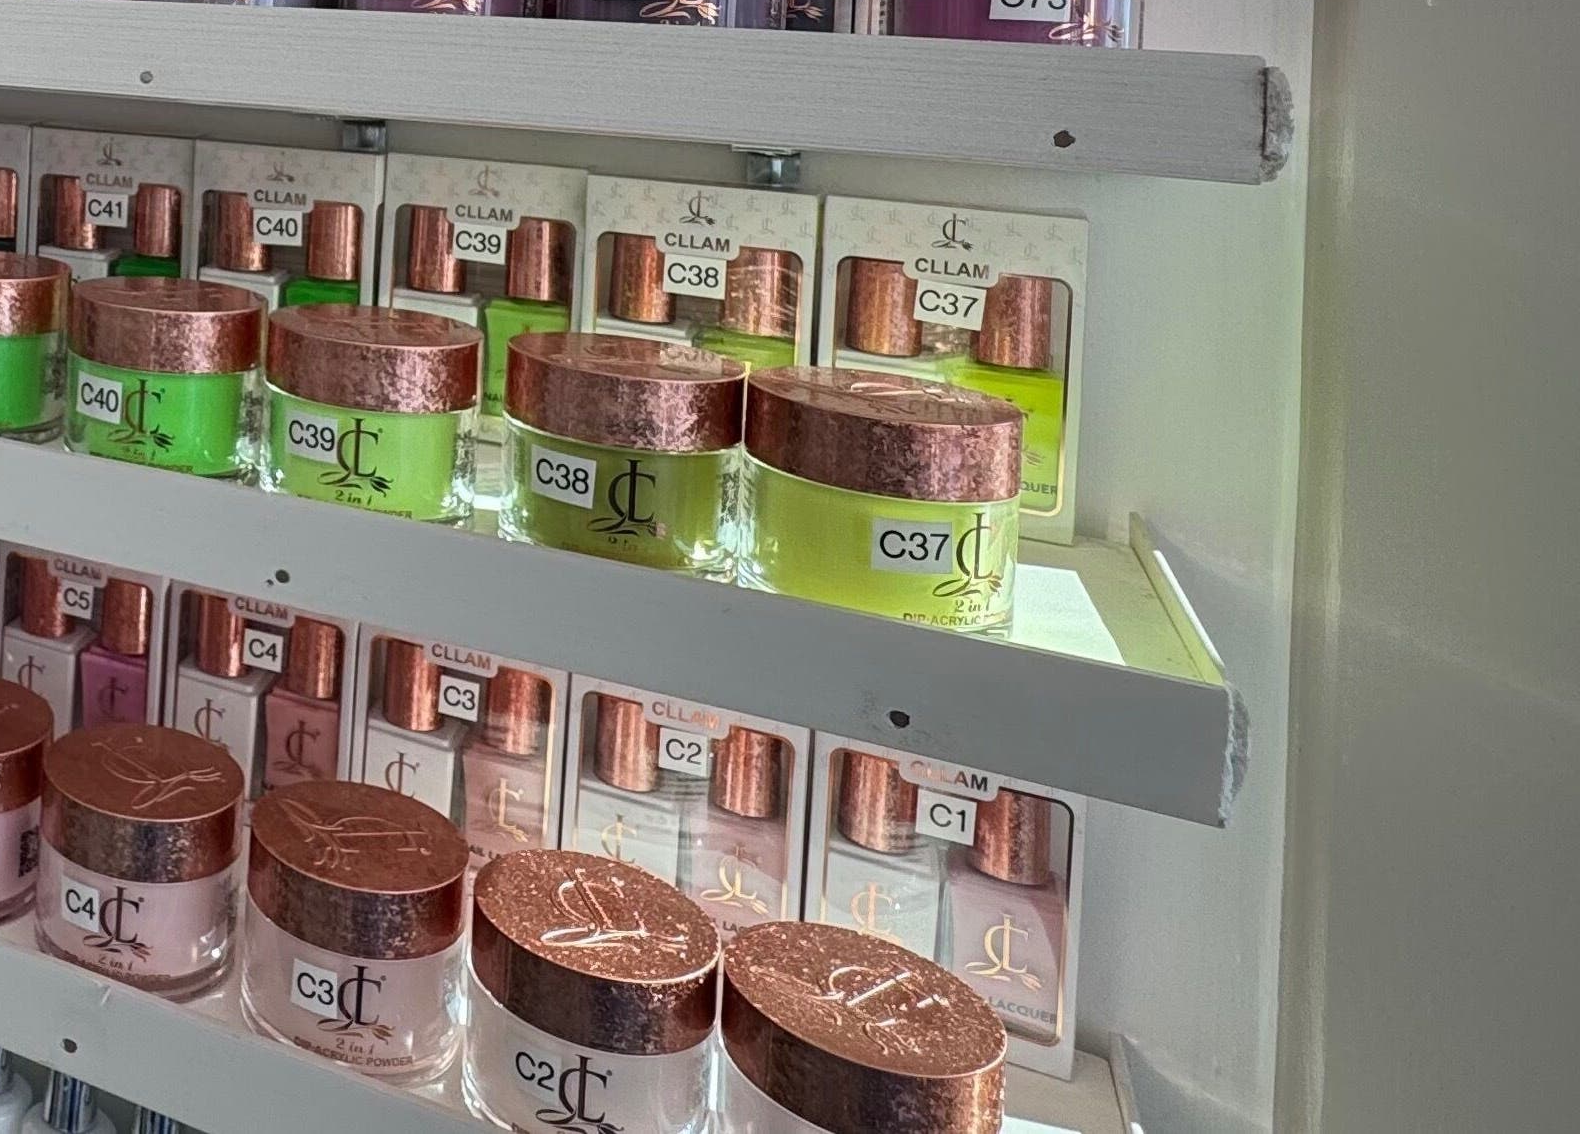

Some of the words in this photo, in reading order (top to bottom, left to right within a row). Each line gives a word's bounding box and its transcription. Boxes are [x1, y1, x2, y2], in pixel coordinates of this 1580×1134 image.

[86, 173, 132, 189] CLLAM
[88, 199, 123, 218] C41
[254, 190, 307, 206] CLLAM
[455, 205, 513, 223] CLLAM
[256, 217, 298, 238] C40
[455, 230, 501, 255] C39
[664, 232, 730, 253] CLLAM
[667, 263, 719, 288] C38
[915, 257, 990, 279] CLLAM
[919, 289, 979, 318] C37
[81, 383, 118, 413] C40
[289, 421, 335, 451] C39
[536, 459, 589, 494] C38
[335, 490, 346, 502] 2
[880, 529, 950, 561] C37
[53, 559, 102, 581] CLLAM
[64, 587, 90, 609] C5
[235, 596, 289, 621] CLLAM
[954, 599, 965, 613] 2
[248, 637, 279, 660] C4
[431, 644, 491, 670] CLLAM
[443, 684, 476, 712] C3
[652, 700, 720, 730] CLLAM
[665, 740, 702, 764] C2
[929, 803, 967, 833] C1
[65, 889, 96, 920] C4
[297, 971, 334, 1007] C3
[335, 1037, 345, 1050] 2
[516, 1051, 556, 1091] C2
